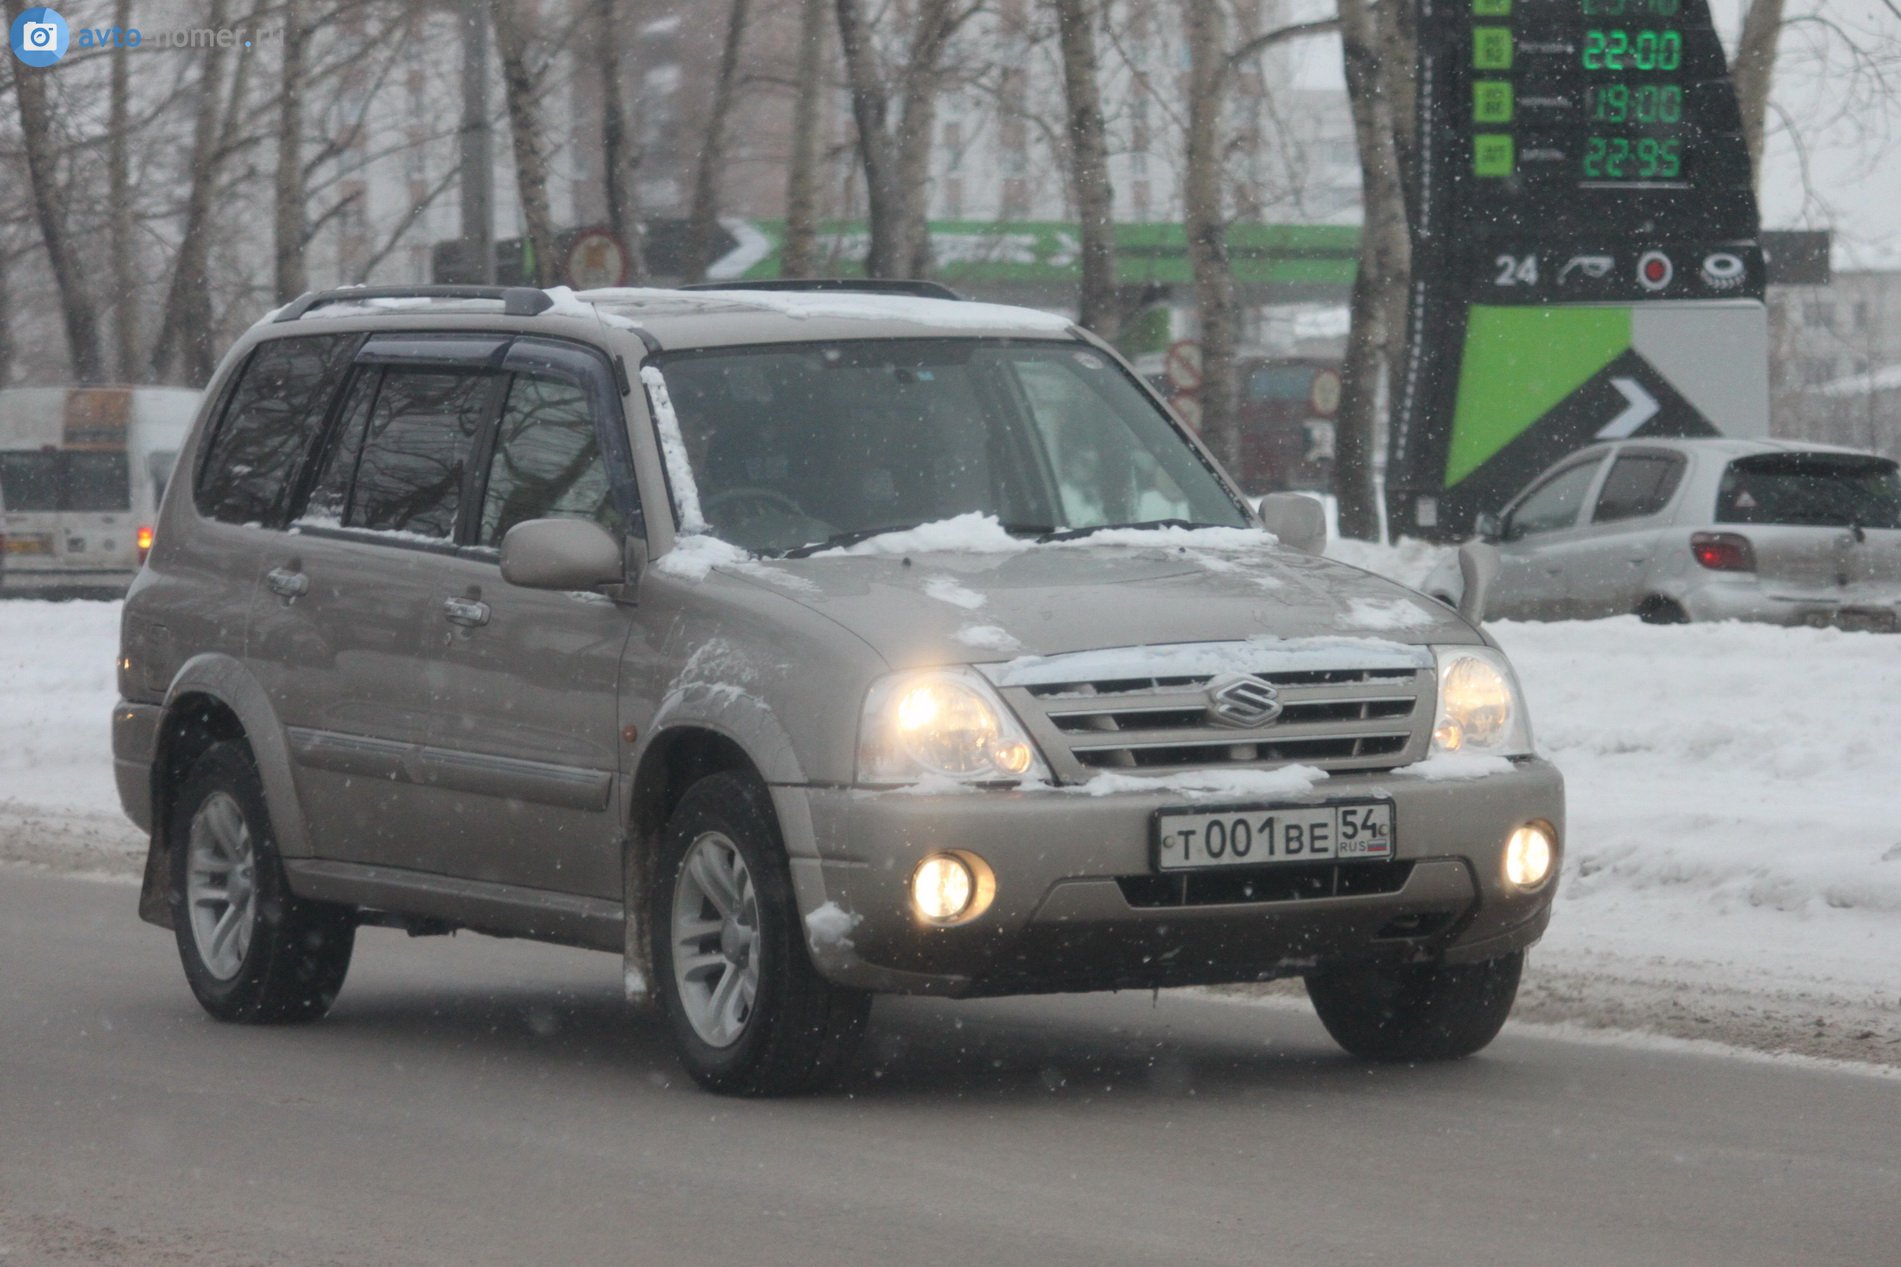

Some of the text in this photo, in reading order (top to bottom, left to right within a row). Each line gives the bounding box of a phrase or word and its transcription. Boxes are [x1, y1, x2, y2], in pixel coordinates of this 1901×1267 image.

[1494, 254, 1538, 287] 24
[1341, 808, 1377, 840] 54
[1339, 840, 1367, 853] RUS
